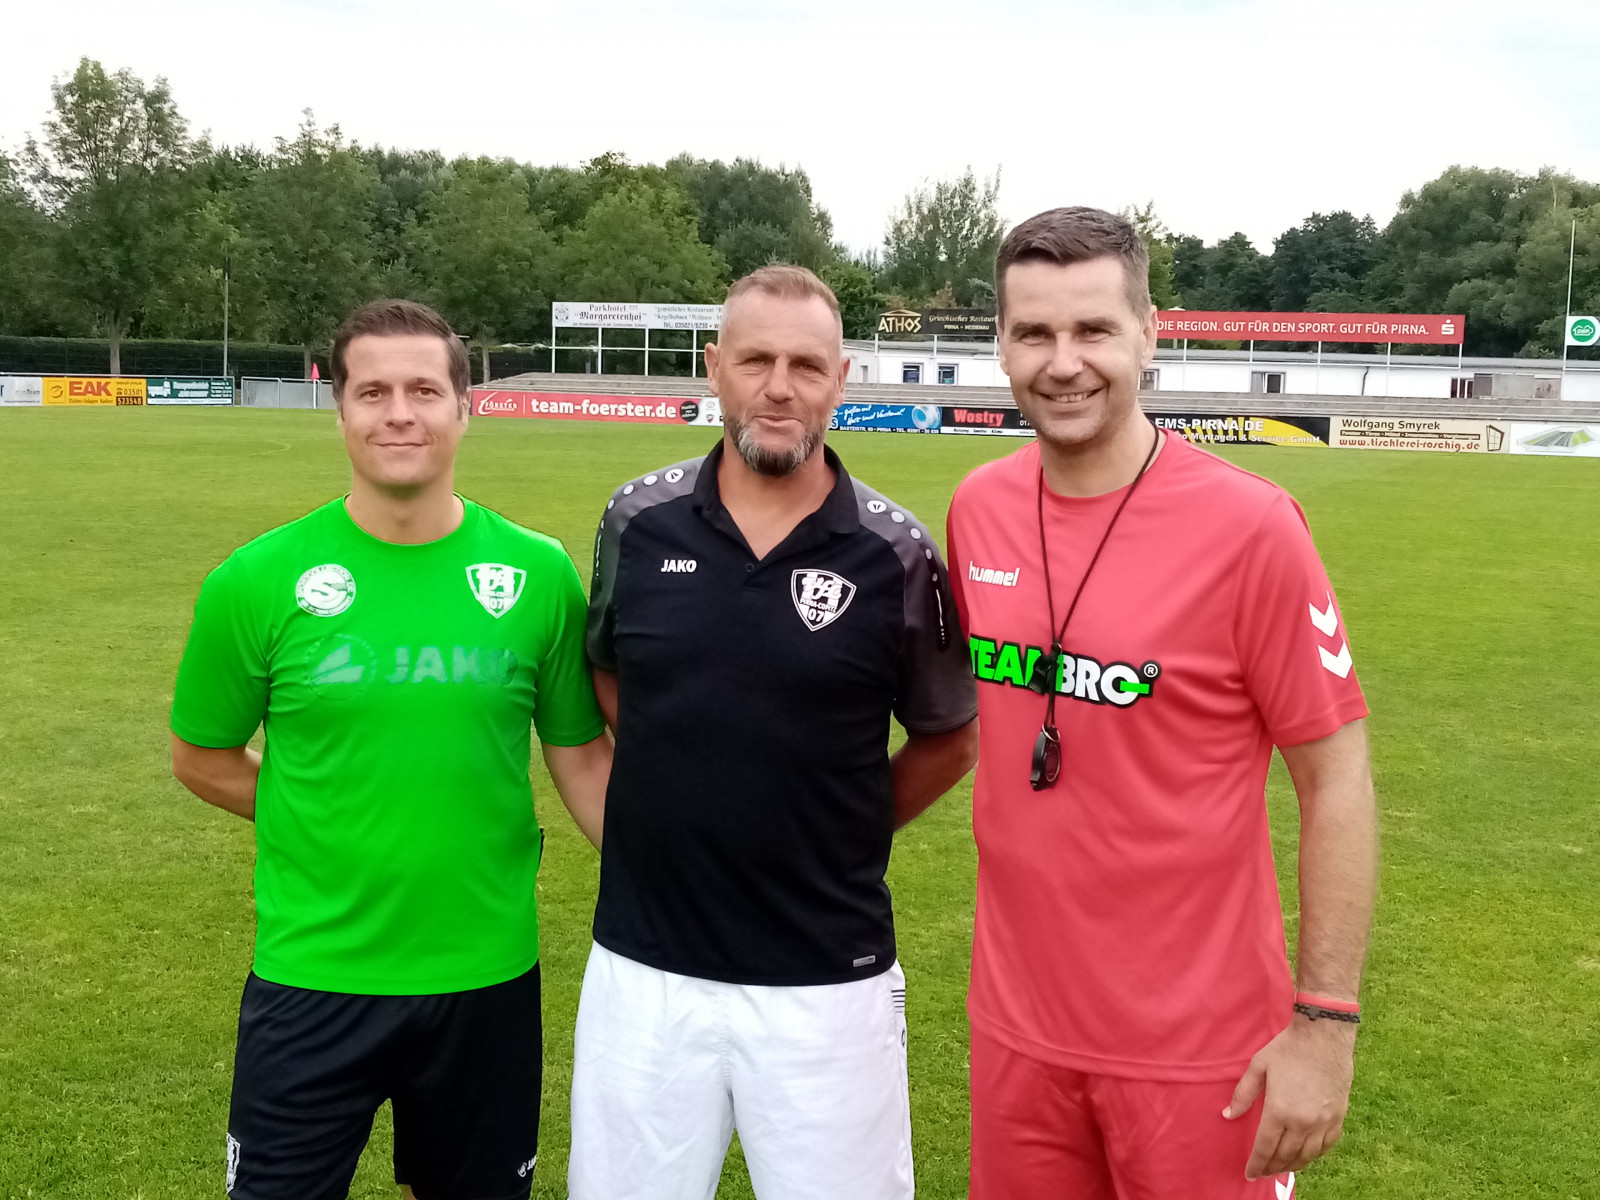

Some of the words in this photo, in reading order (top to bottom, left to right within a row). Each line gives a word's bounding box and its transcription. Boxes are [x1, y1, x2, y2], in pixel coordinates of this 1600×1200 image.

[589, 304, 627, 316] Parkhotel
[877, 316, 922, 333] ATHOS
[1157, 320, 1175, 331] DIE
[1177, 321, 1220, 332] REGION.
[1223, 321, 1246, 332] GUT
[1248, 320, 1269, 332] FÜR
[1272, 322, 1295, 333] DEN
[1298, 323, 1337, 334] SPORT.
[1339, 323, 1363, 334] GUT
[1365, 321, 1388, 334] FÜR
[1391, 324, 1429, 335] PIRNA.
[69, 381, 113, 396] EAK
[123, 388, 143, 396] 03501
[531, 398, 676, 418] team-foerster.de
[953, 409, 1004, 427] Wostry
[1155, 417, 1264, 432] EMS-PIRNA.DE
[1342, 419, 1395, 431] Wolfgang
[1398, 420, 1441, 431] Smyrek
[1190, 432, 1237, 443] Montagen
[1251, 434, 1287, 443] Service
[1290, 435, 1320, 443] GmbH
[1339, 438, 1480, 453] www.tischlerei-roschig.de
[660, 559, 697, 573] JAKO
[968, 560, 1020, 587] hummel
[807, 608, 825, 622] 07
[386, 645, 519, 687] JAKO
